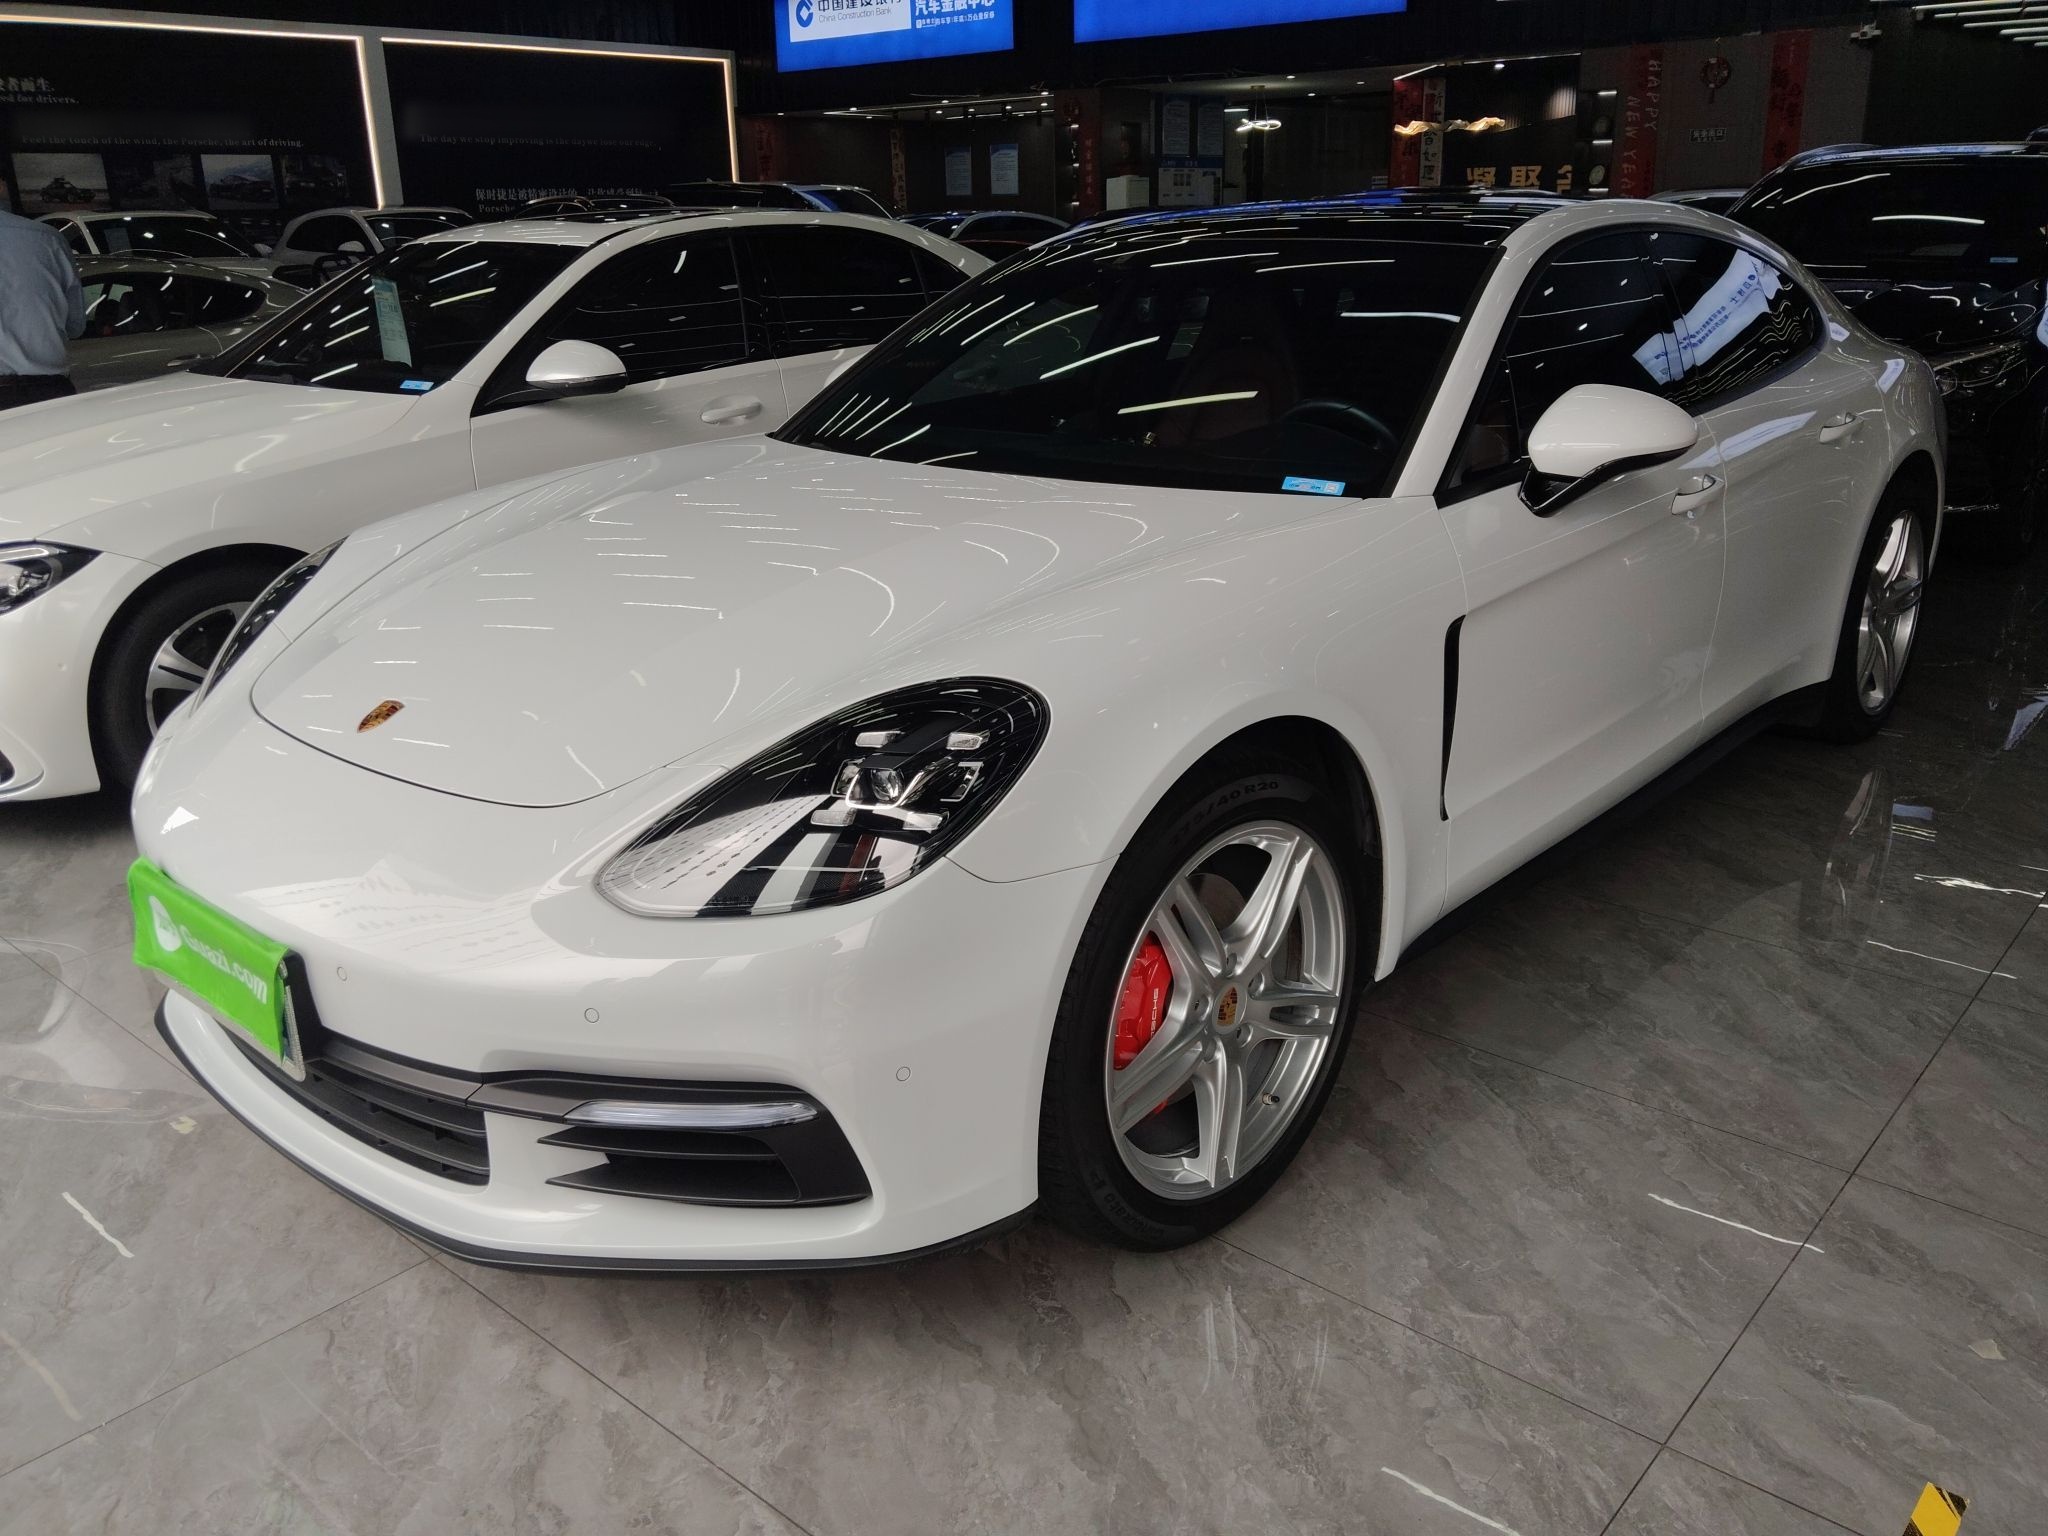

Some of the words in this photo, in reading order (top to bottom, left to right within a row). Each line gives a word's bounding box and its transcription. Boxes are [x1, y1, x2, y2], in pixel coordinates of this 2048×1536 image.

[818, 14, 836, 23] China
[838, 7, 874, 21] Construction
[876, 6, 892, 14] Bank
[1644, 59, 1662, 131] HAPPY
[22, 136, 47, 145] Feel
[49, 136, 66, 145] the
[69, 136, 99, 145] touch
[101, 136, 113, 145] of
[114, 136, 131, 145] the
[133, 137, 161, 146] wind,
[163, 137, 178, 147] the
[181, 137, 223, 147] Porsche,
[225, 138, 240, 147] the
[241, 138, 255, 147] art
[257, 138, 268, 147] of
[269, 138, 304, 149] driving.
[420, 134, 438, 144] The
[440, 134, 457, 146] day
[459, 136, 473, 144] we
[475, 135, 496, 147] stop
[498, 136, 544, 147] improving
[546, 138, 554, 146] is
[555, 138, 571, 146] the
[600, 139, 618, 148] lose
[619, 140, 634, 148] our
[1619, 149, 1638, 197] YEA
[1244, 781, 1279, 794] R20
